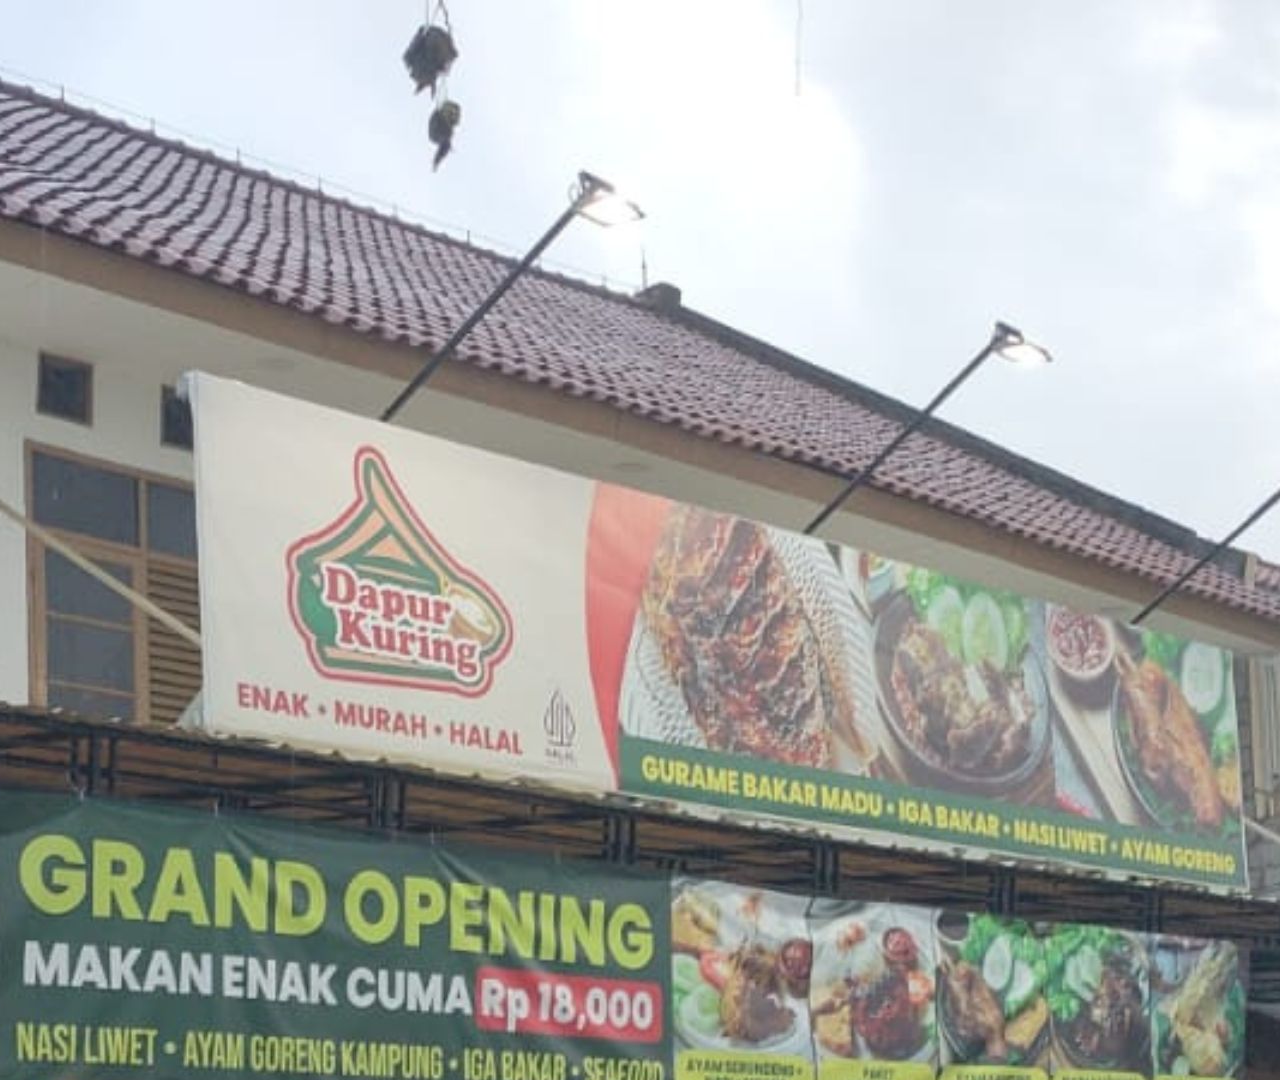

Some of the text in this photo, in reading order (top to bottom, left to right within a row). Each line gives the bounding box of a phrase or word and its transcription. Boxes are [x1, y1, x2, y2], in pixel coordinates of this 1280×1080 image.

[325, 565, 451, 625] Dapur
[338, 608, 478, 677] Kuring
[237, 682, 524, 755] ENAK MURAH HALAL
[641, 755, 1236, 875] GURAME BAKAR MADU IGA BAKAR NASI LIWET AYAM GORENG
[19, 834, 654, 970] GRAND OPENING
[23, 940, 654, 1032] MAKAN ENAK CUMA Rp 18,000
[16, 1021, 77, 1062] NASI
[84, 1025, 158, 1067] LIWET
[183, 1030, 245, 1070] AYAM
[250, 1034, 335, 1077] GORENG
[341, 1040, 444, 1080] KAMPUNG
